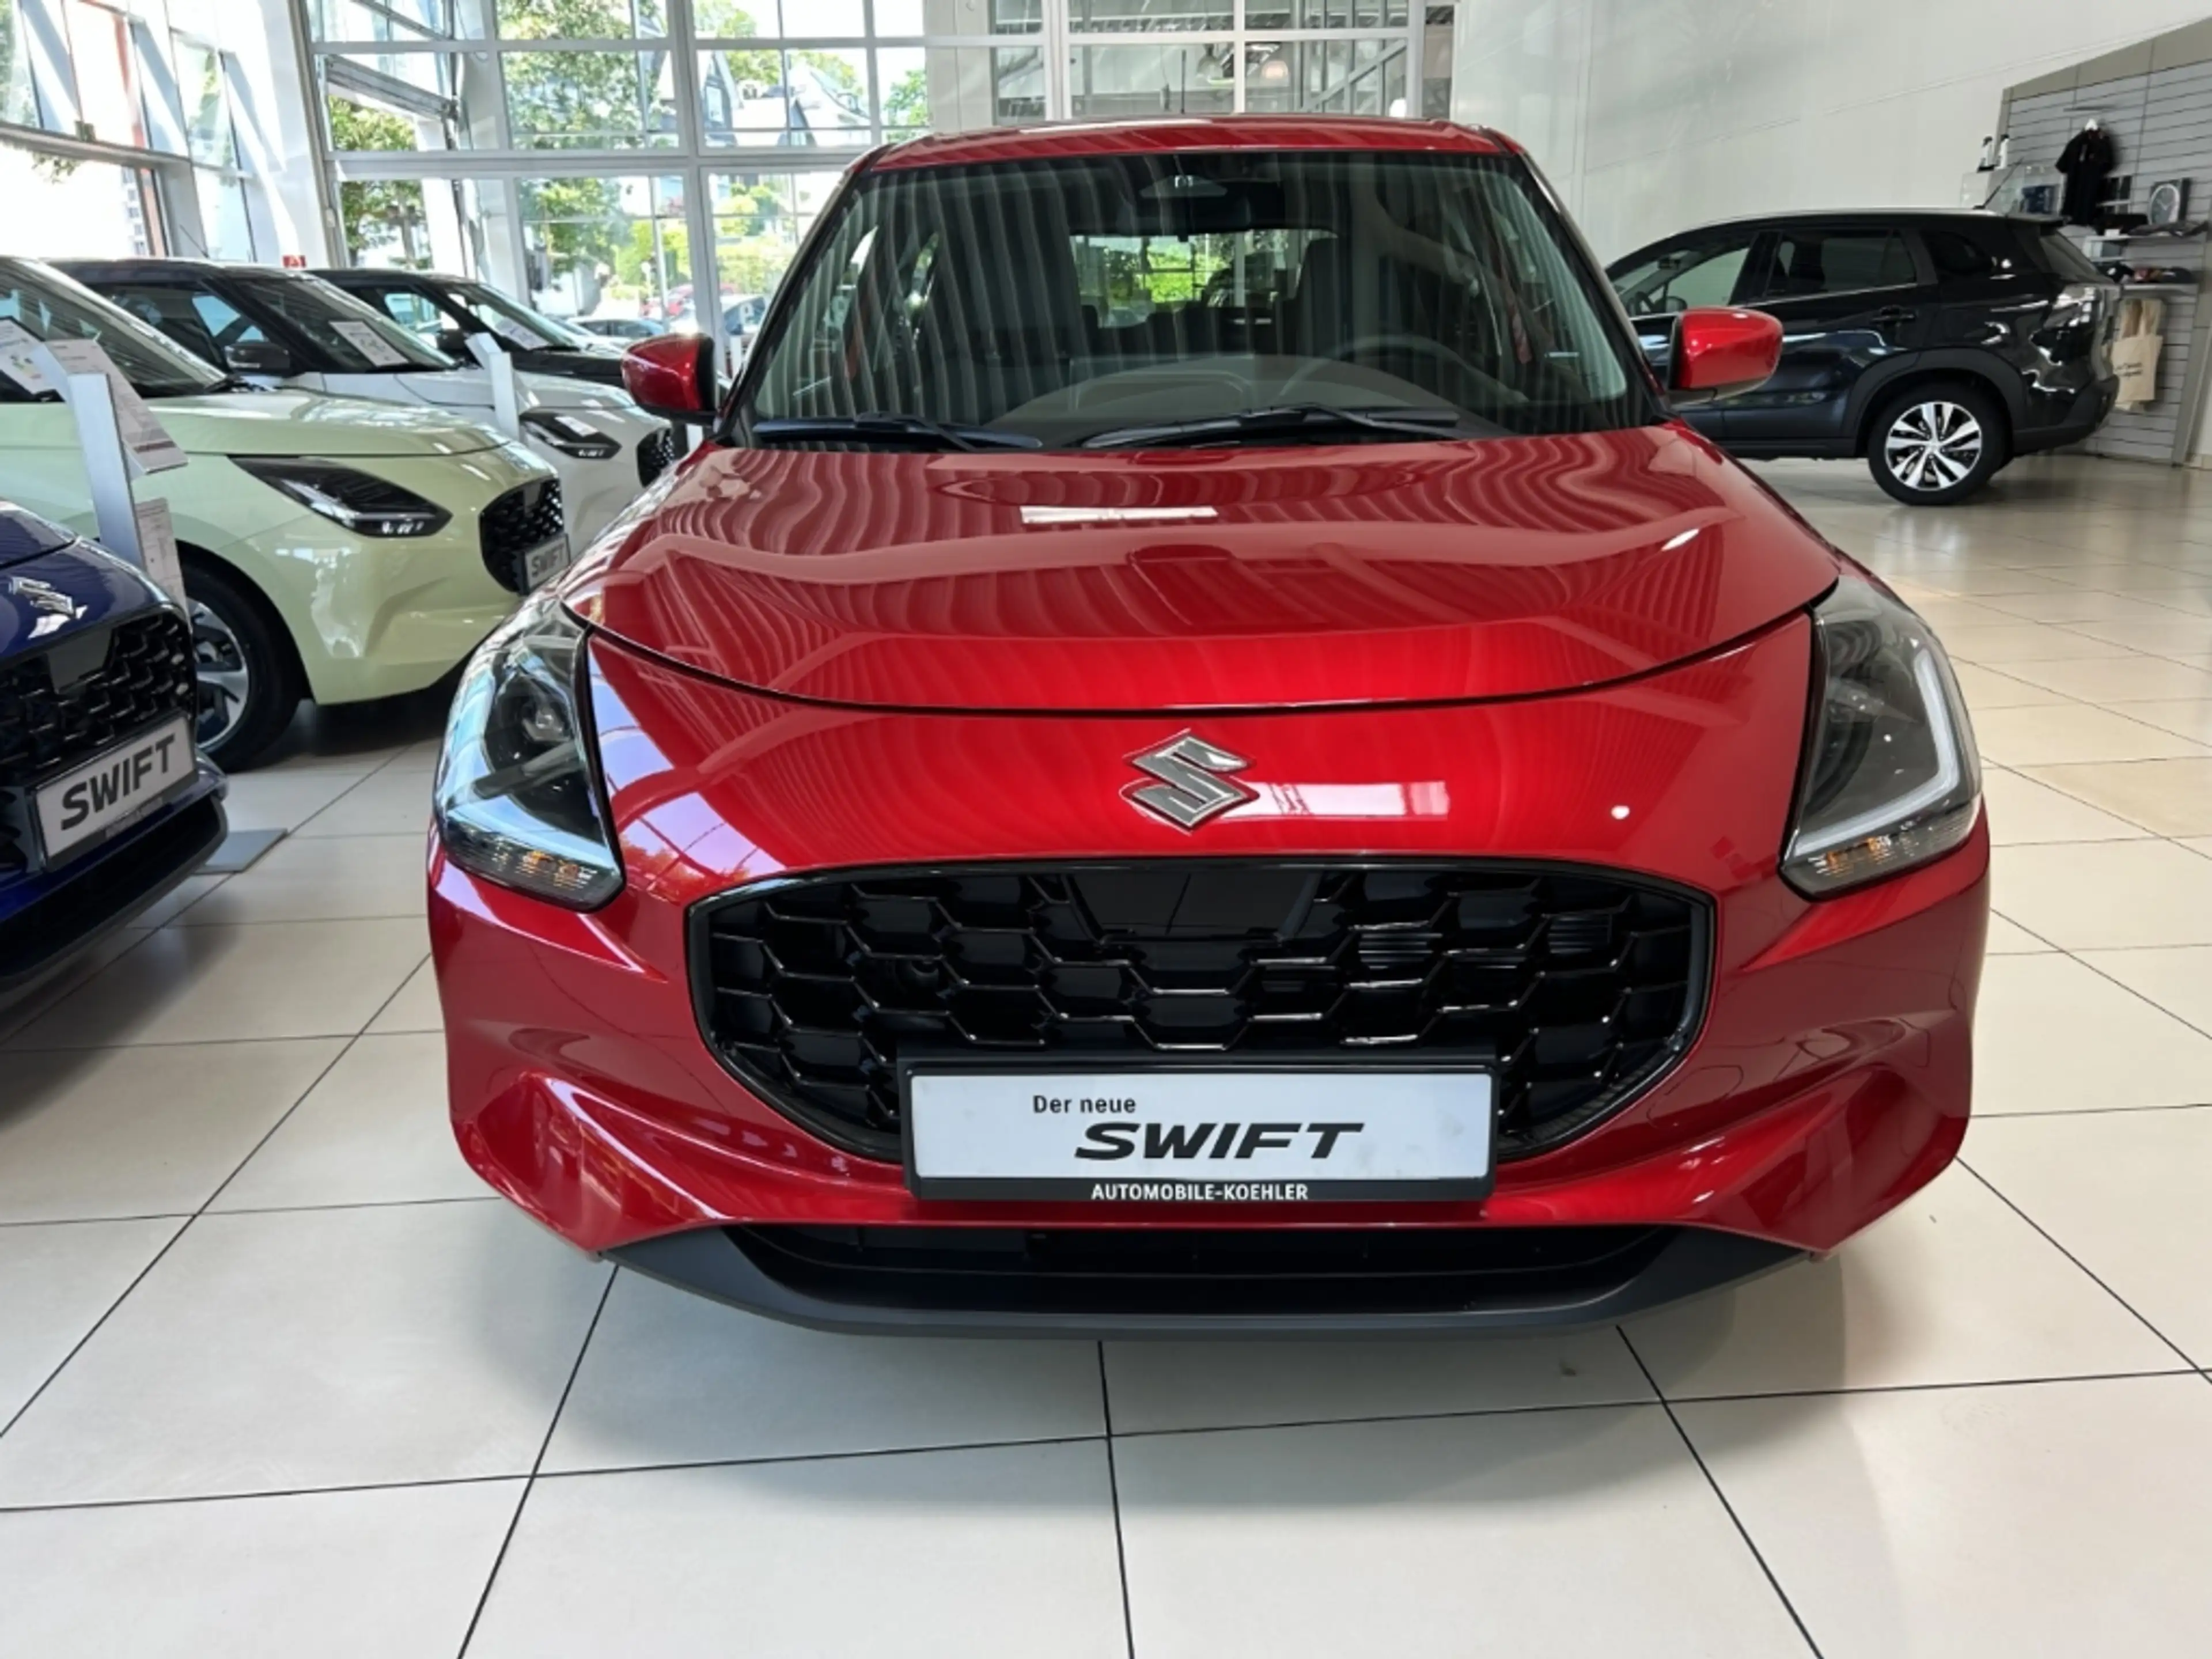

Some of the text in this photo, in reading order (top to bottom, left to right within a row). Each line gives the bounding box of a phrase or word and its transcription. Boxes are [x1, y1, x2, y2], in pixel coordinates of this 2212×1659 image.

[60, 733, 175, 831] SWIFT
[1033, 1095, 1136, 1113] Der neue
[1074, 1122, 1365, 1160] SWIFT
[1091, 1183, 1308, 1200] AUTOMOBILE-KOEHLER
